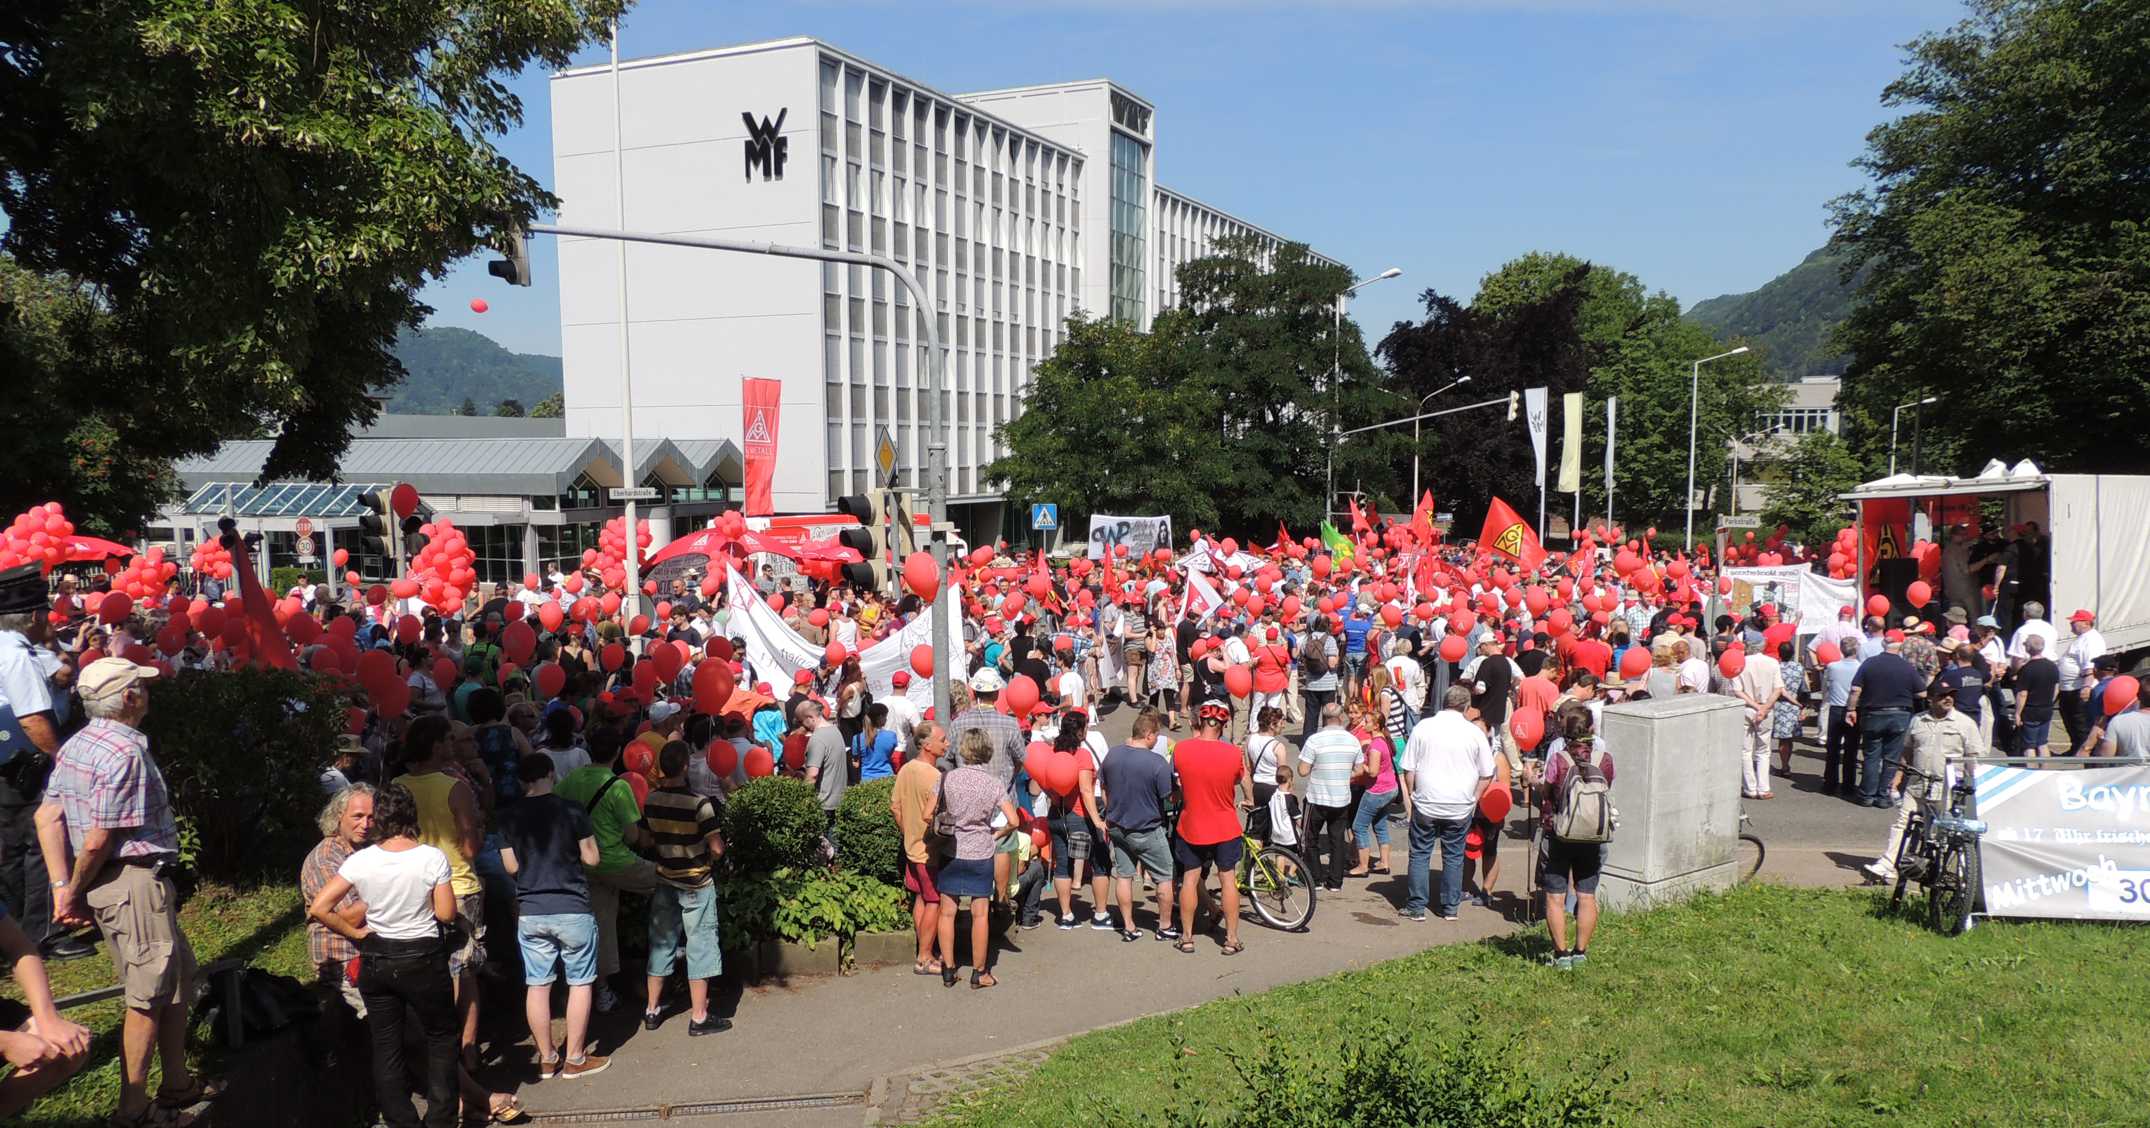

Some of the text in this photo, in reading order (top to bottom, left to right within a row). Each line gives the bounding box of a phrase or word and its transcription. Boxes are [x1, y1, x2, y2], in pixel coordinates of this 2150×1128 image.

[297, 523, 312, 531] STOP
[300, 542, 310, 551] 30
[1986, 854, 2119, 910] Mittwoch
